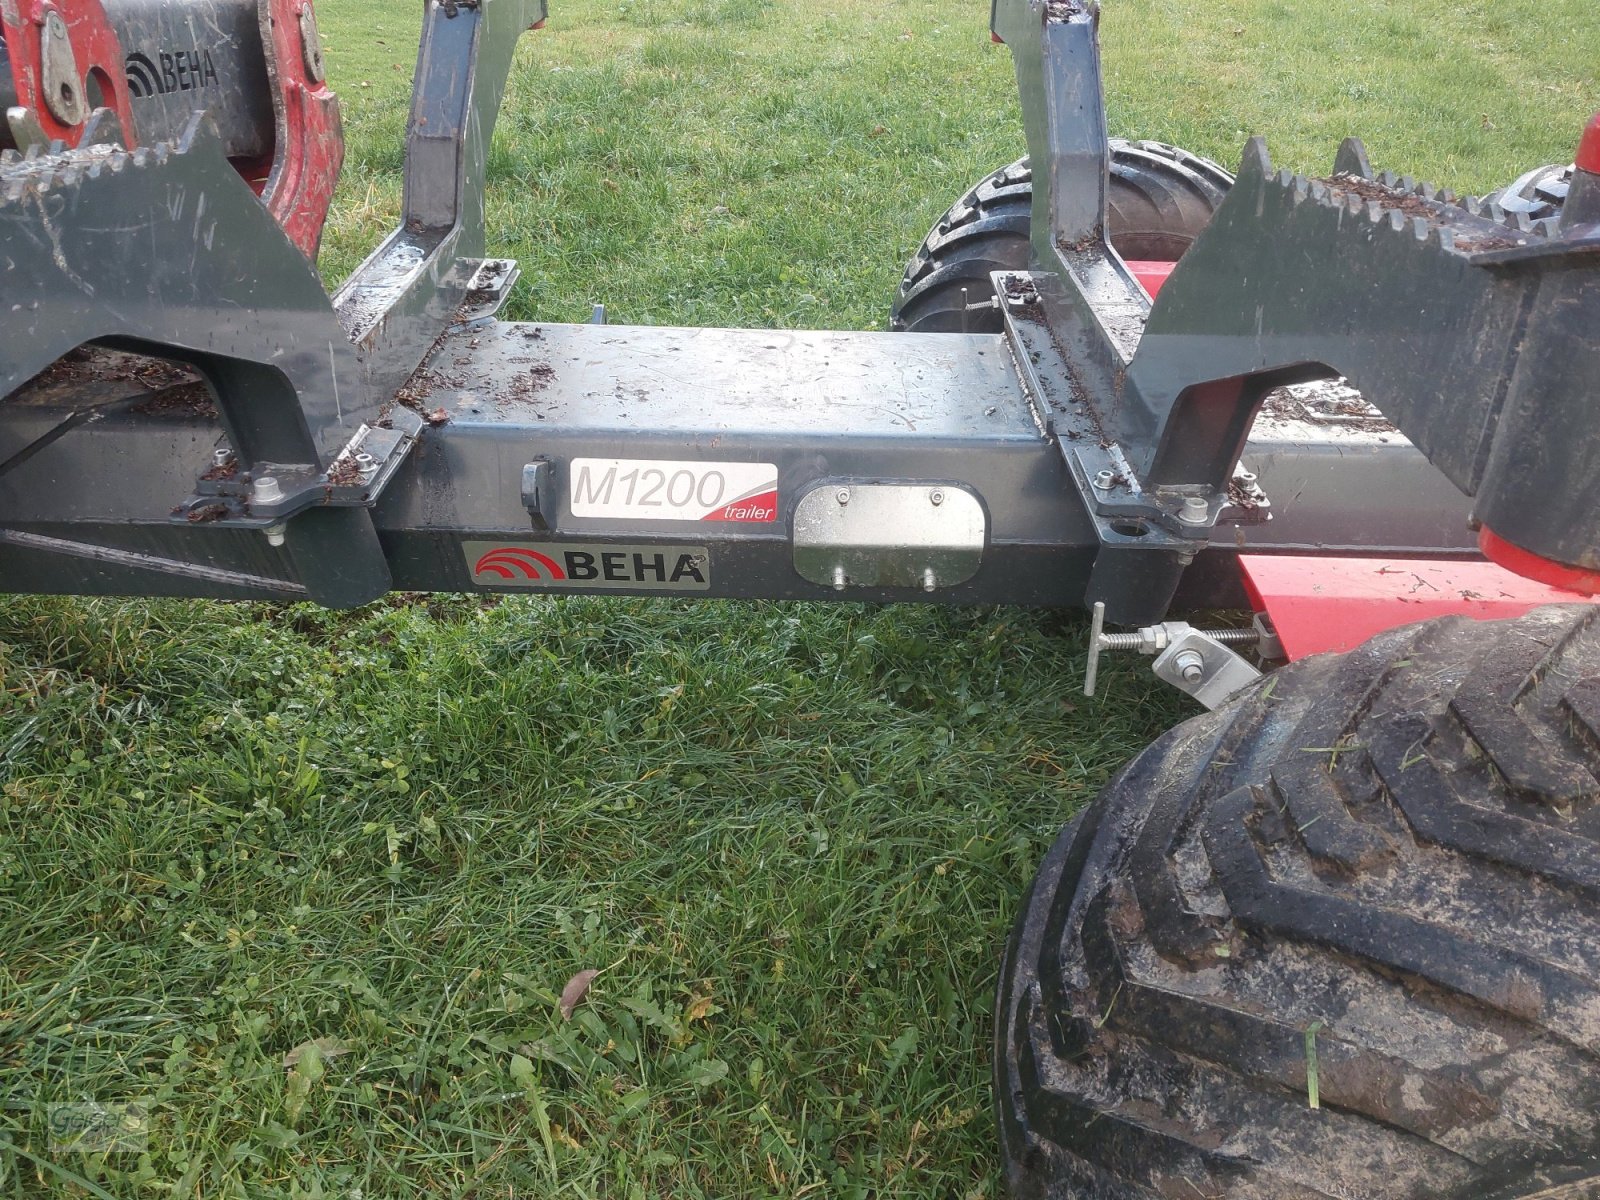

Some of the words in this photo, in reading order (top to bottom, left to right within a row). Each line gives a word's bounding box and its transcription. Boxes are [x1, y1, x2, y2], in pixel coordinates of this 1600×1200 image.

[159, 49, 219, 93] BEHA
[573, 466, 726, 508] M1200
[724, 505, 774, 520] trailer
